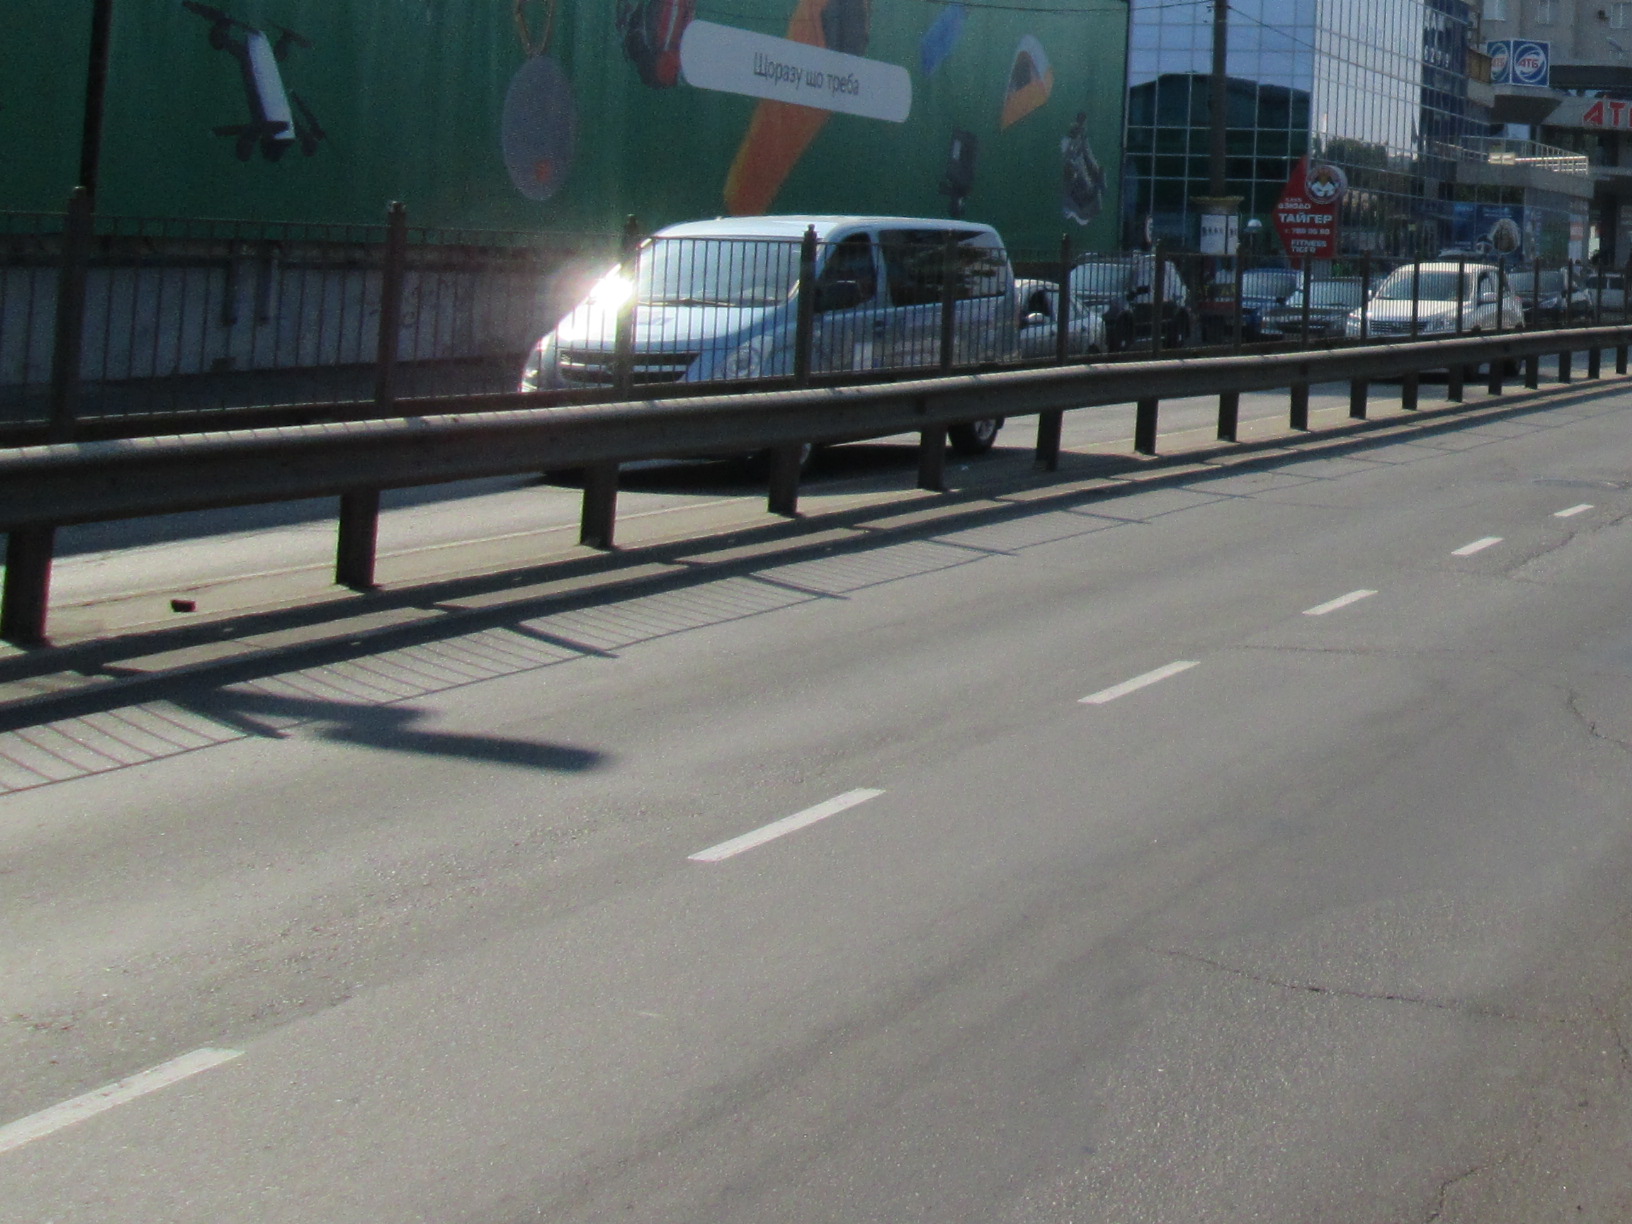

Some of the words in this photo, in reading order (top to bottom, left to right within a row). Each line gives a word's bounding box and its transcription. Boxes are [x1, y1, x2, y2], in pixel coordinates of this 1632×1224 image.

[1517, 58, 1540, 69] АТБ
[753, 52, 802, 91] Щоразу
[827, 73, 860, 98] треба
[1278, 211, 1333, 224] ТАЙГЕР
